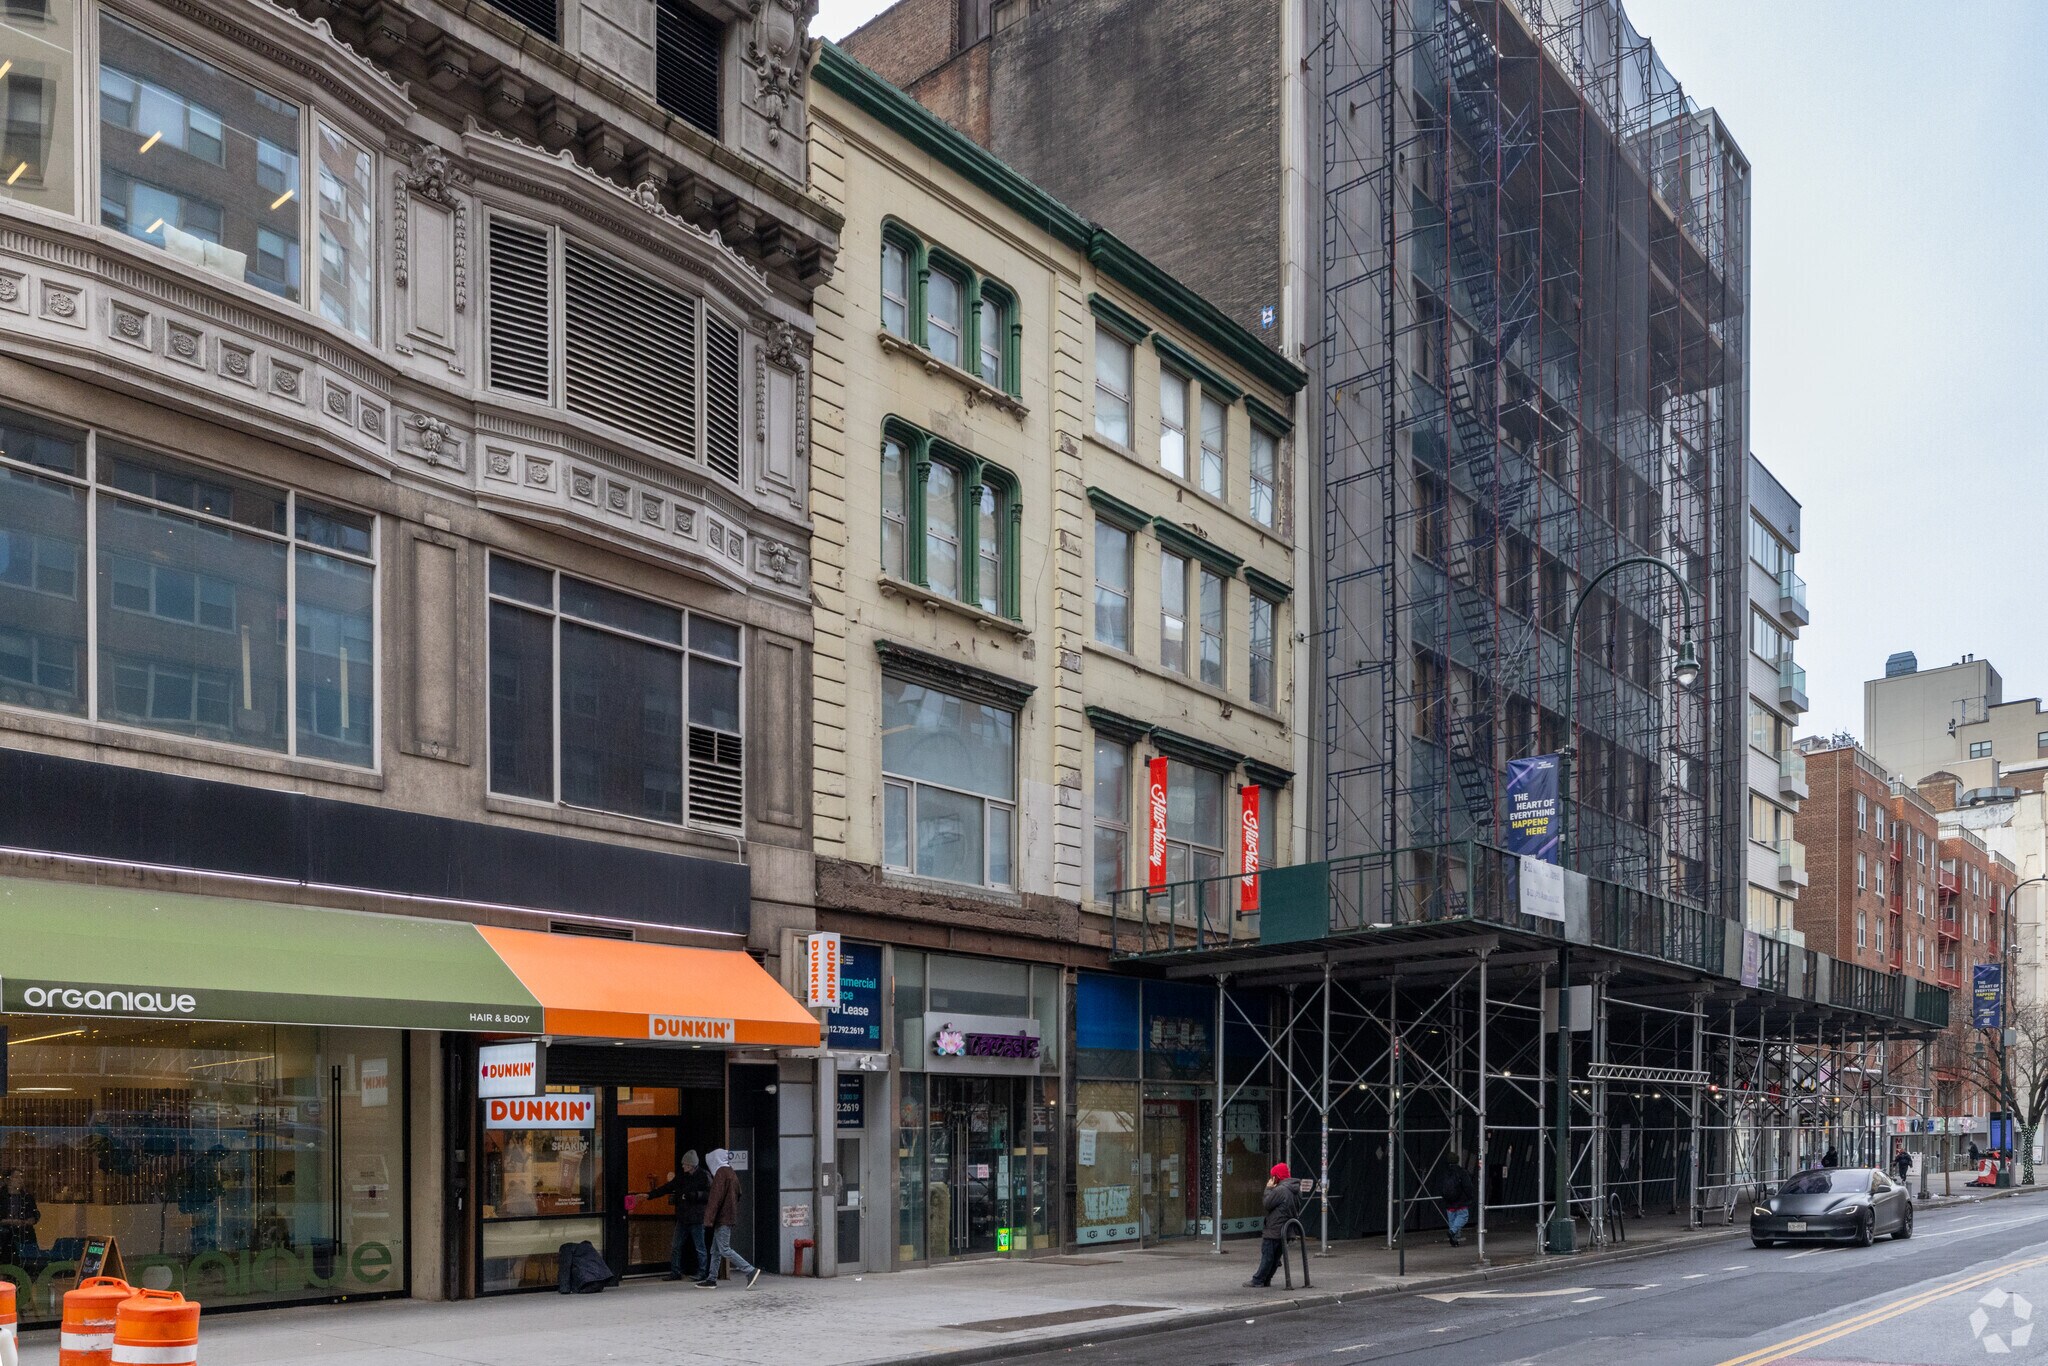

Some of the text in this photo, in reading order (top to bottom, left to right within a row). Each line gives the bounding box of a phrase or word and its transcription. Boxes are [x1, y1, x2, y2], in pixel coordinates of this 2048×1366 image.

[1513, 792, 1529, 802] THE
[1516, 798, 1555, 811] HEART OF
[1509, 808, 1556, 821] EVERYTHING
[1512, 817, 1549, 829] HAPPENS
[1526, 826, 1547, 836] HERE
[1150, 821, 1166, 867] Valley
[811, 940, 820, 1003] DUNKIN'
[827, 940, 836, 1003] DUNKIN'
[840, 977, 877, 989] mmercial
[23, 986, 197, 1013] organique
[842, 1003, 869, 1016] Lease
[469, 1013, 530, 1024] HAIR & BODY
[654, 1018, 731, 1039] DUNKIN'
[829, 1025, 865, 1035] 12.792.2619
[490, 1062, 534, 1079] DUNKIN'
[491, 1100, 591, 1121] DUNKIN'
[836, 1103, 860, 1112] 2.2619
[551, 1141, 589, 1152] SHAKIN'
